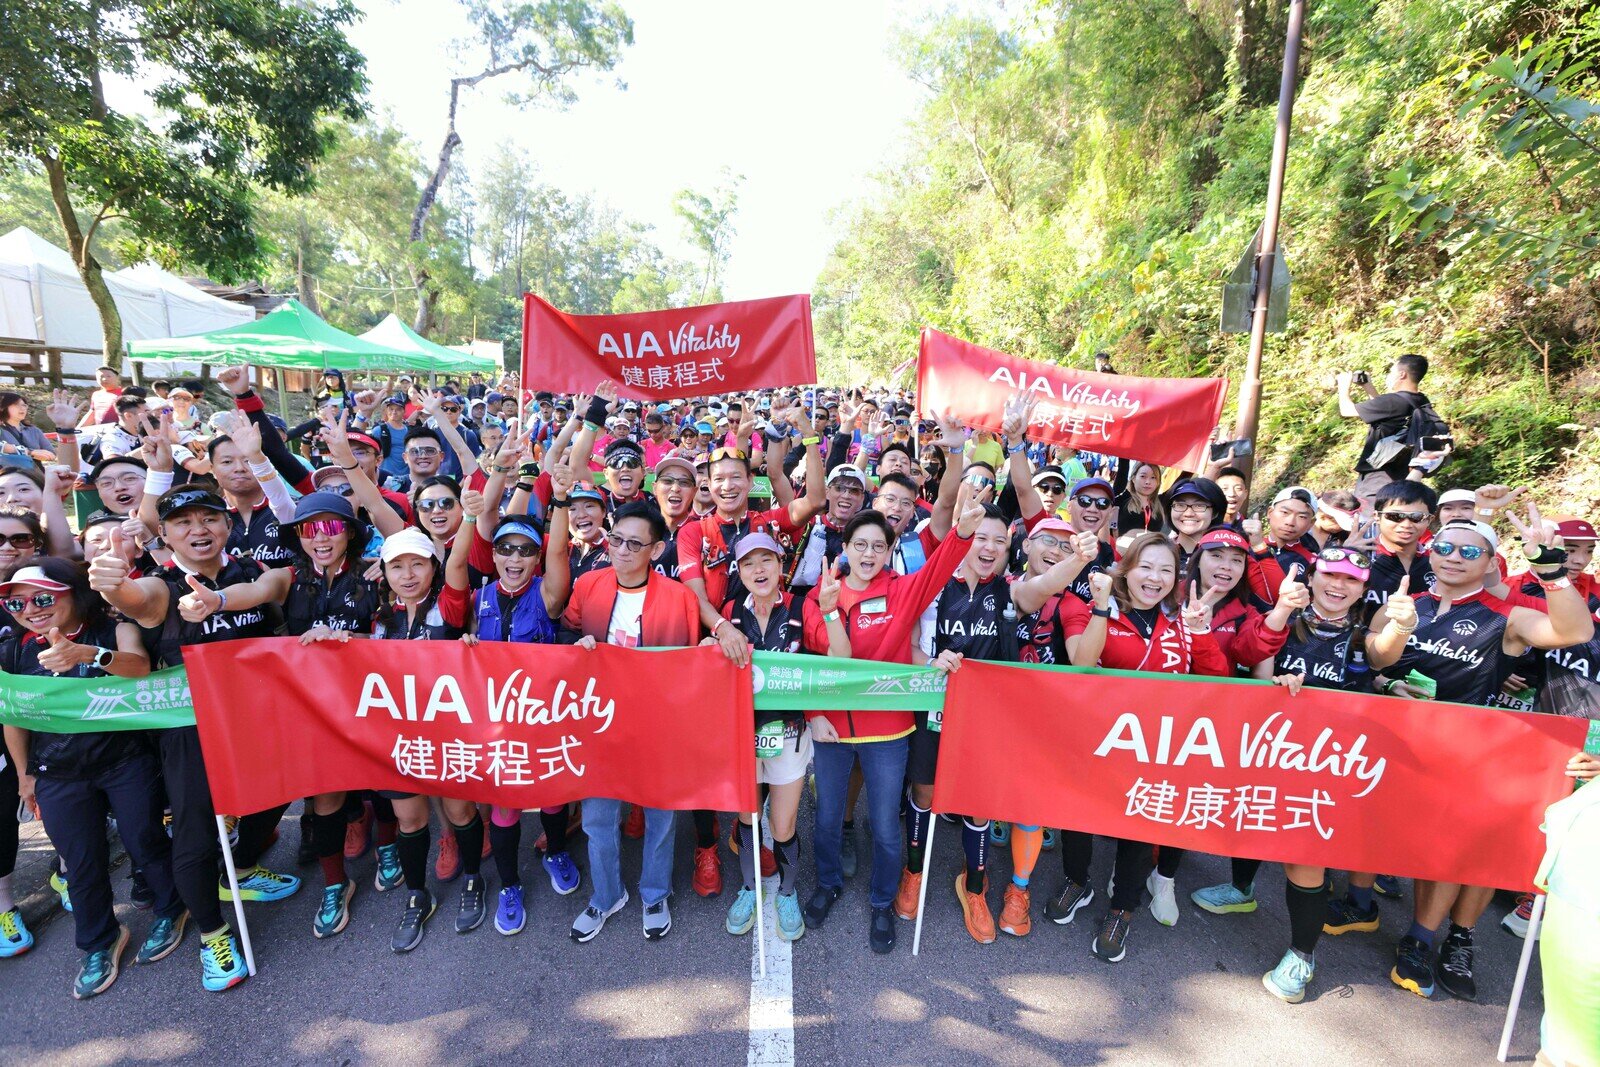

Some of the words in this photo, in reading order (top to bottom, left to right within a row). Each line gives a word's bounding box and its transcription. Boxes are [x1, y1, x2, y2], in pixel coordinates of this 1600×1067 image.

[598, 330, 664, 358] AIA
[668, 321, 741, 357] Vitality
[621, 357, 725, 390] 健康程式
[988, 366, 1056, 399] AIA
[1062, 381, 1141, 419] Vitality
[1003, 394, 1115, 442] 康程式
[200, 613, 232, 636] IA
[136, 677, 190, 691] 樂施毅
[1280, 654, 1307, 674] IA
[354, 672, 473, 724] AIA
[487, 668, 615, 734] Vitality
[767, 680, 803, 691] OXFAM
[390, 733, 586, 787] 健康程式
[1092, 712, 1226, 768] AIA
[1239, 711, 1387, 798] Vitality
[1124, 776, 1336, 840] 健康程式
